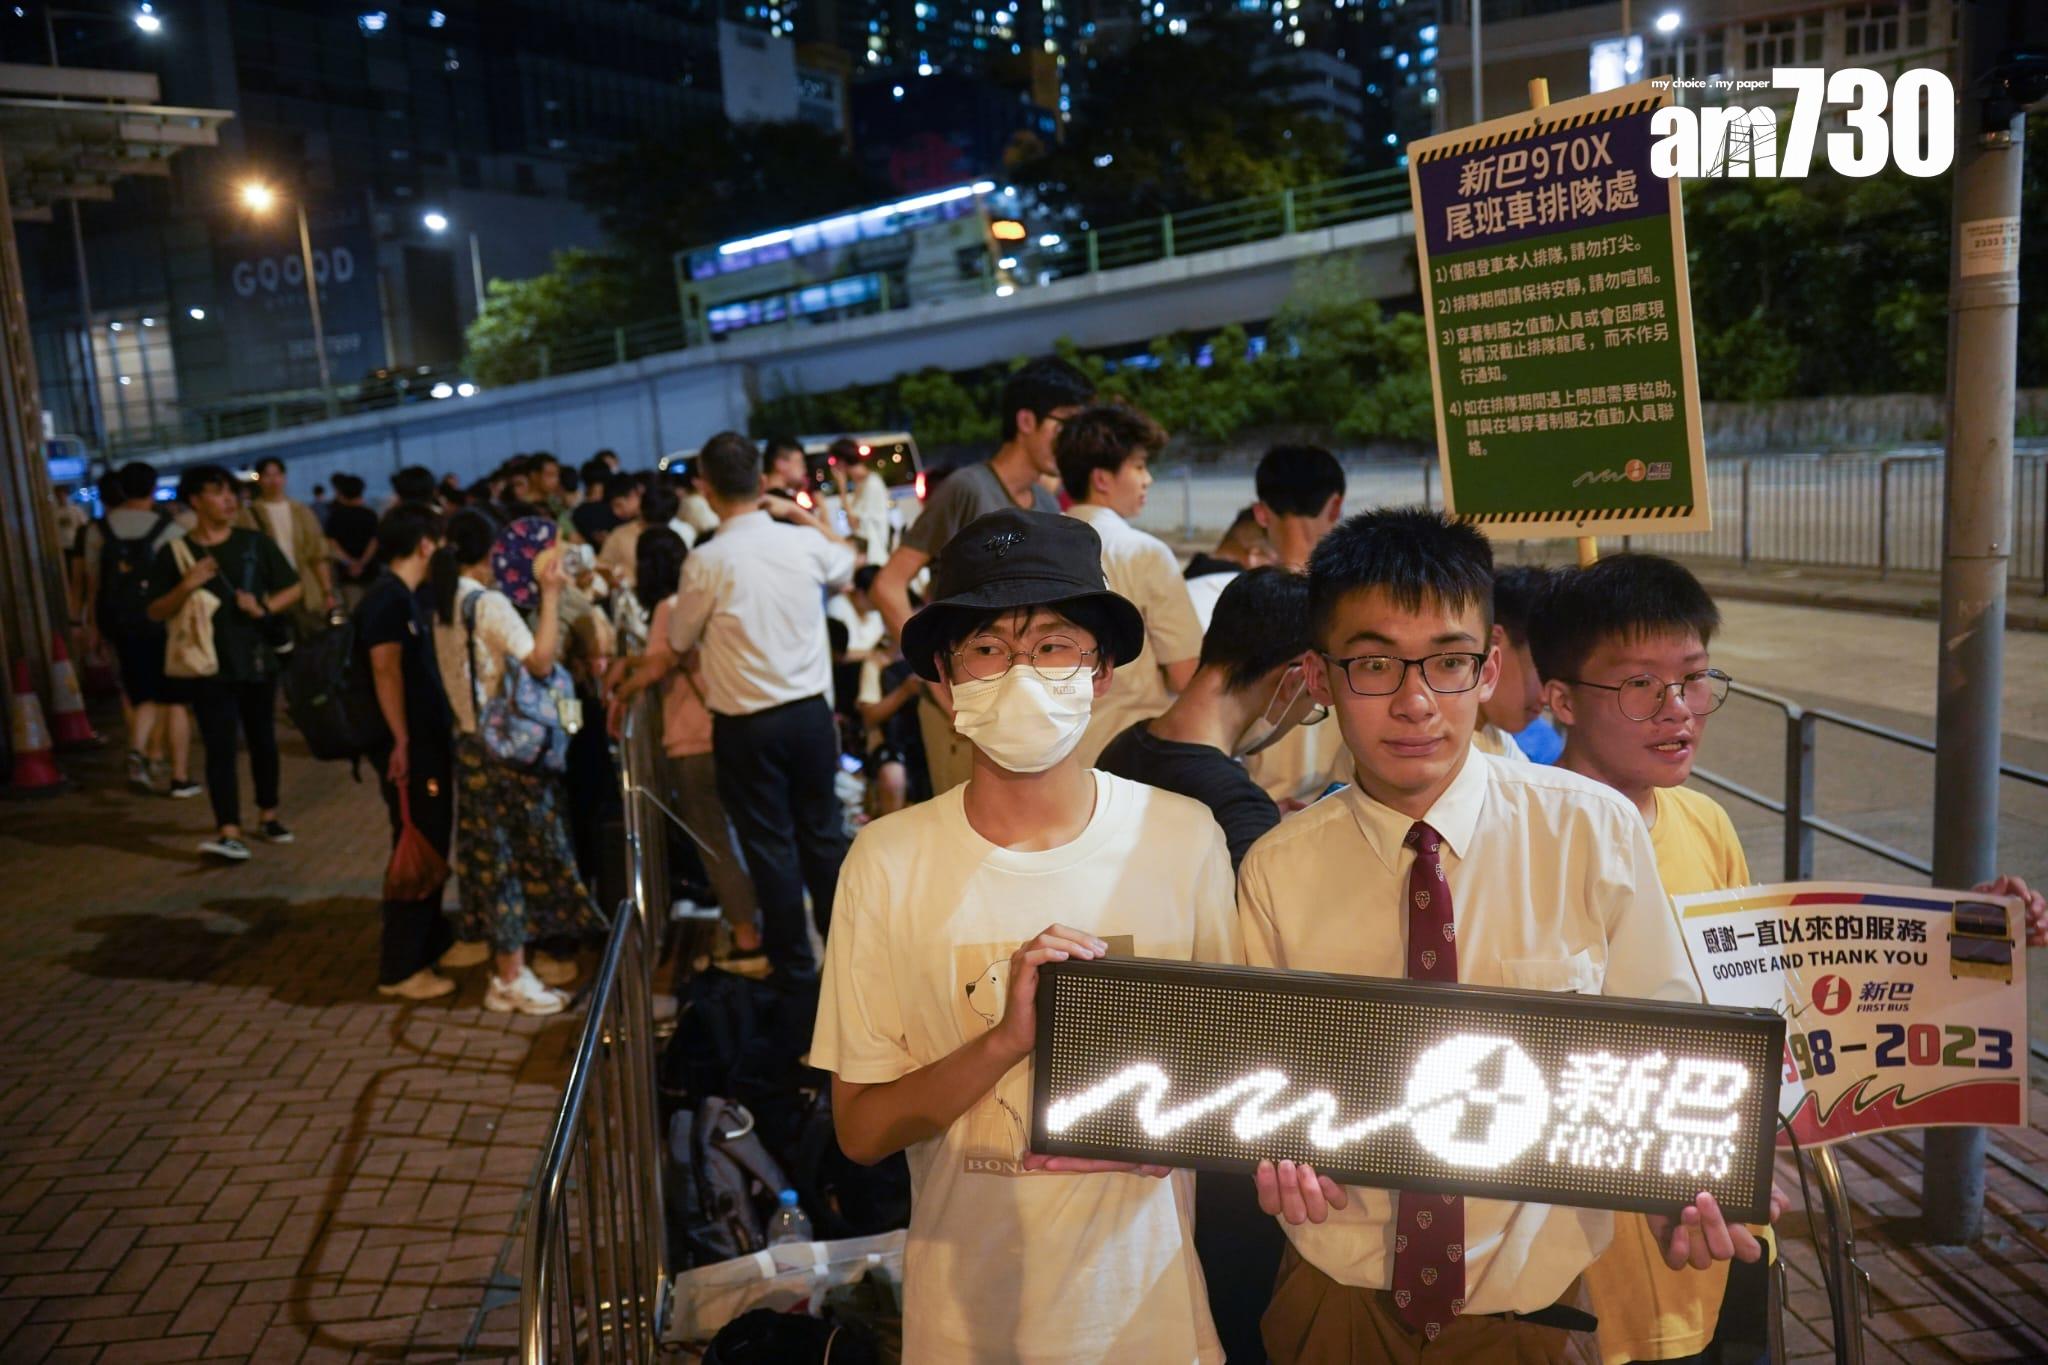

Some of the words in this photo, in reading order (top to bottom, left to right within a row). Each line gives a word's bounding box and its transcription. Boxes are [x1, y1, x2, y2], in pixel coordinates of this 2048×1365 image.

[1457, 132, 1613, 198] 新巴970X
[1446, 169, 1639, 243] 尾班車排隊處
[1702, 915, 1927, 955] 感謝一直以來的服務
[1712, 958, 1767, 981] GOODBYE
[1770, 953, 1804, 971] AND
[1808, 950, 1878, 966] THANK
[1881, 950, 1928, 966] YOU
[1857, 1003, 1885, 1012] FIRST
[1887, 1003, 1909, 1012] BUS
[1858, 981, 1914, 1001] 新巴
[1553, 1049, 1749, 1137] 新巴
[968, 1159, 1025, 1174] BON
[1548, 1124, 1655, 1172] FIRST
[1660, 1133, 1736, 1179] BUS
